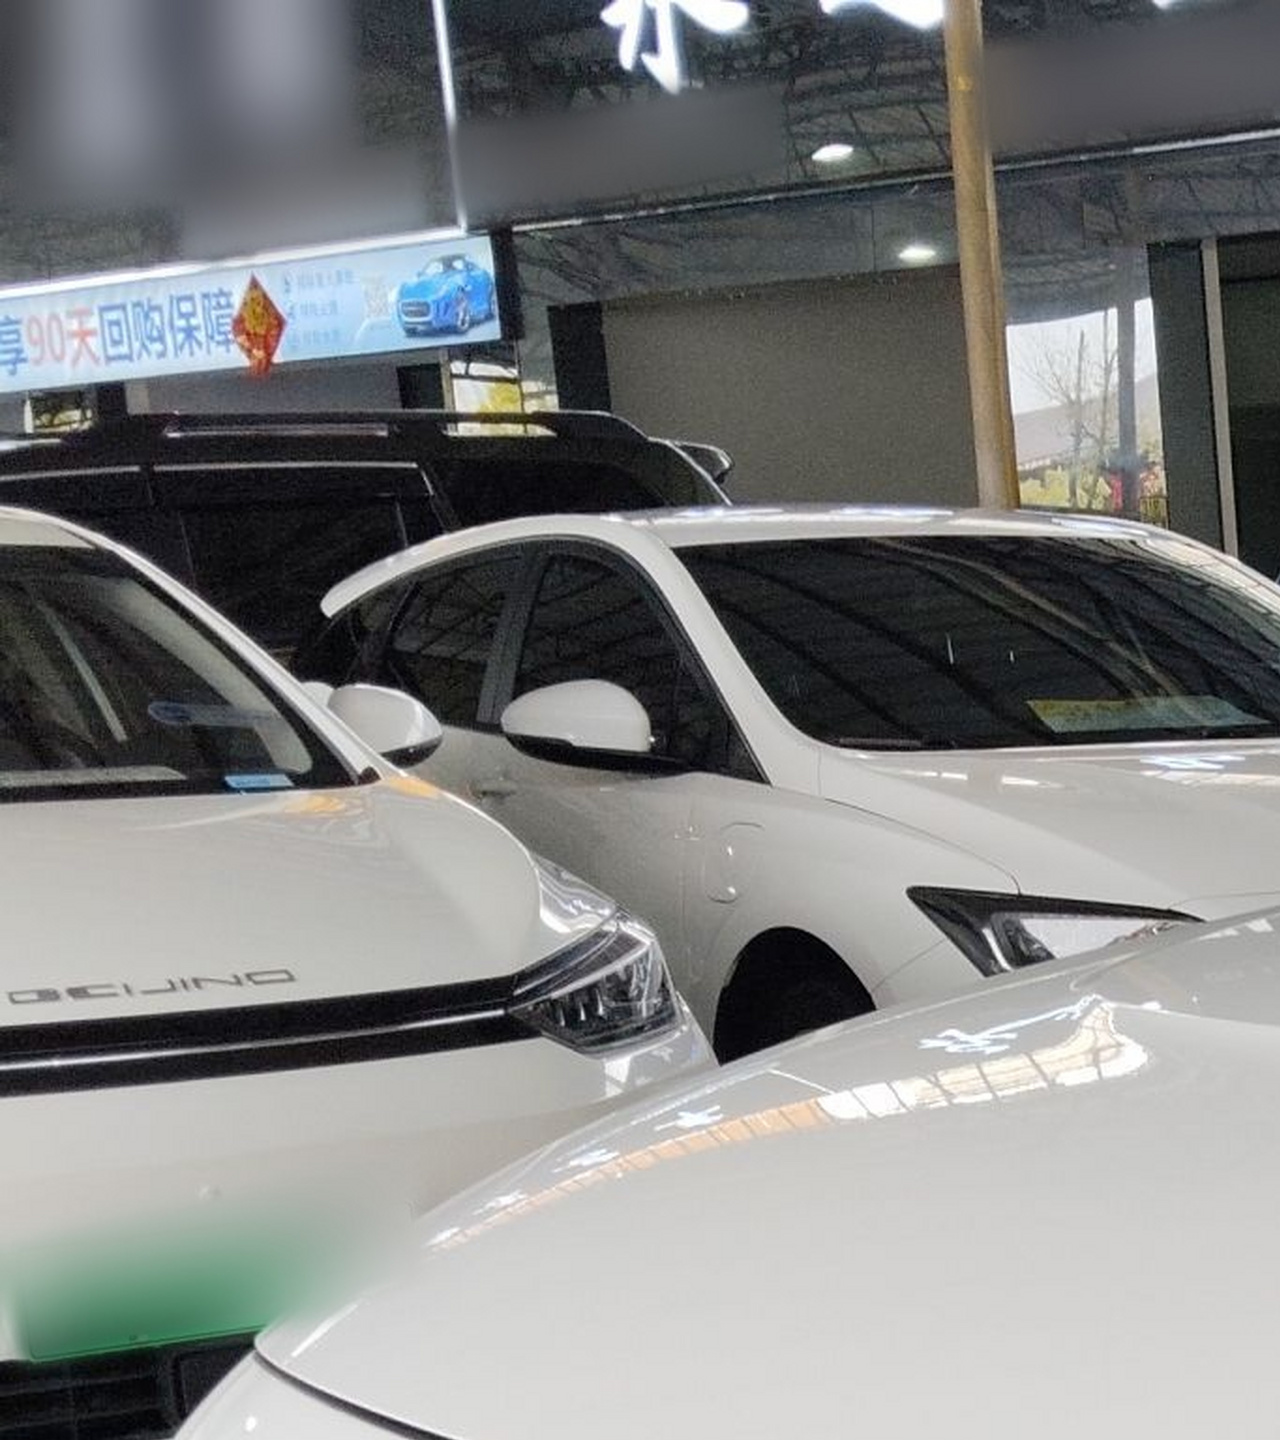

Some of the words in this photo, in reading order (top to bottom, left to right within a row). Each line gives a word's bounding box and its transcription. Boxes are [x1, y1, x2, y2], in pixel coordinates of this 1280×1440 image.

[0, 287, 236, 376] 享90天回购保障
